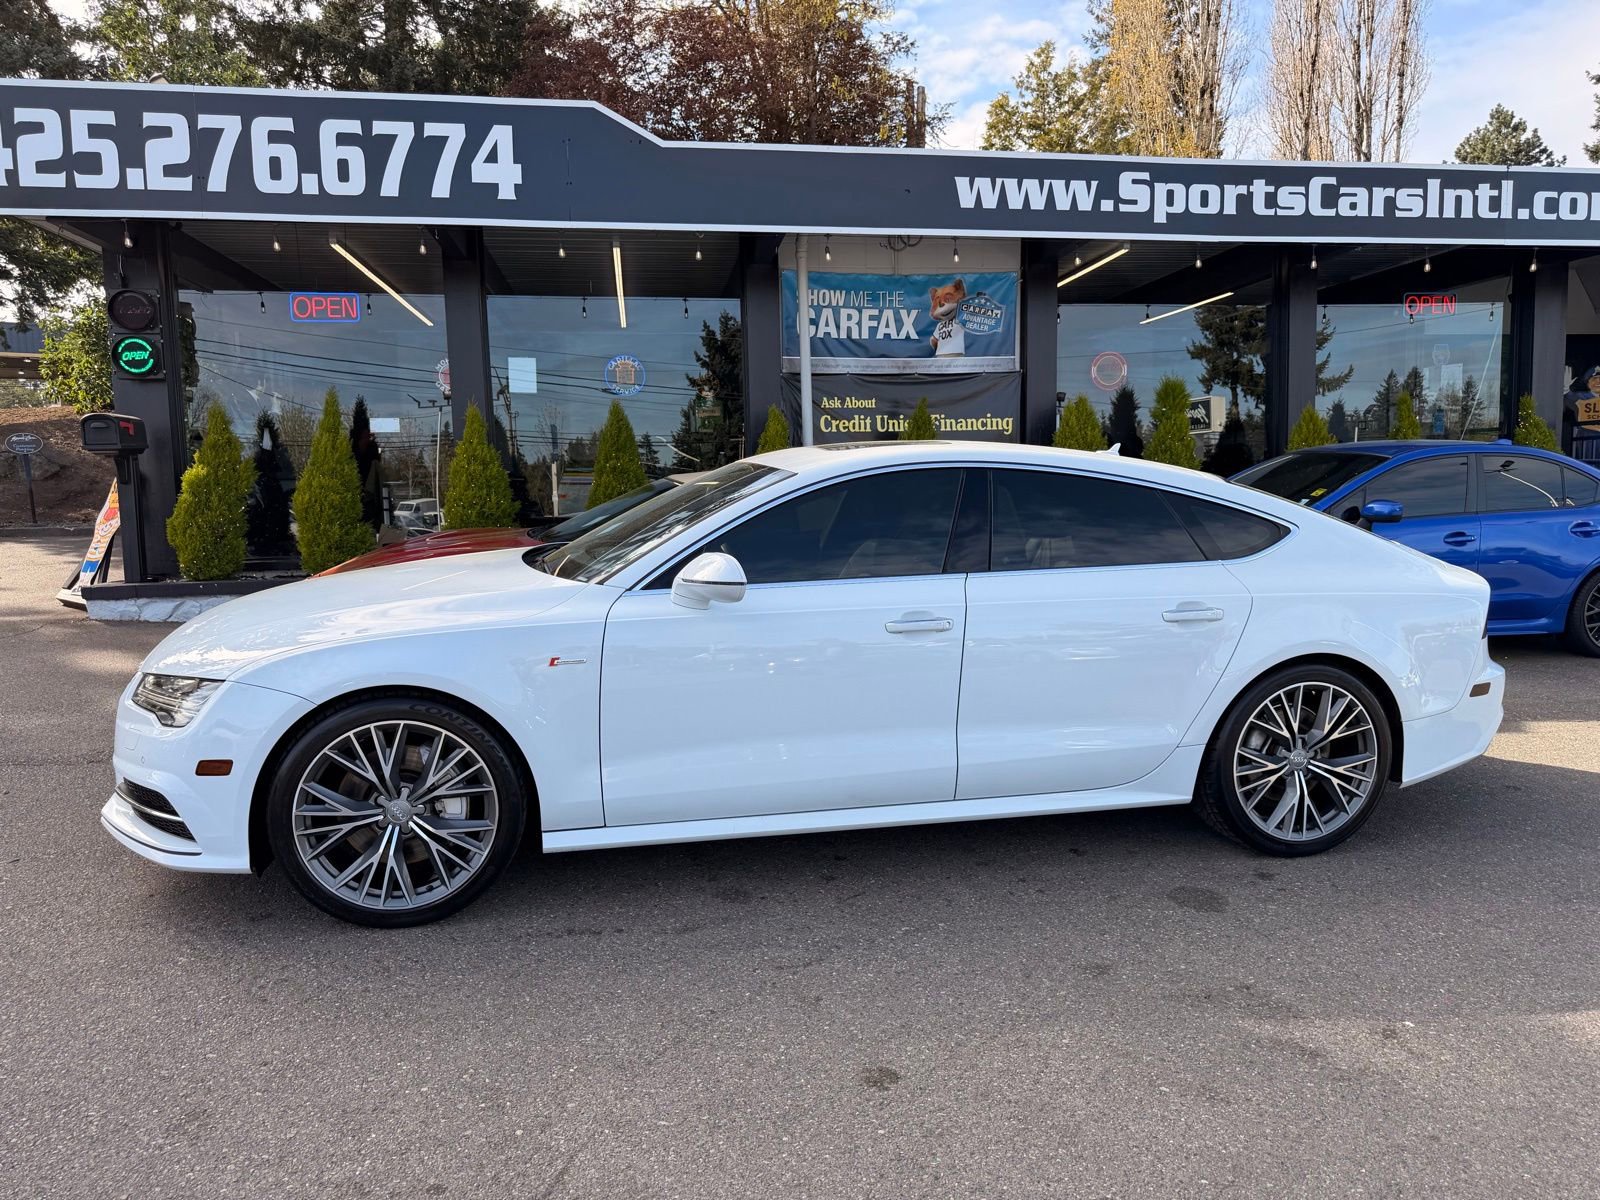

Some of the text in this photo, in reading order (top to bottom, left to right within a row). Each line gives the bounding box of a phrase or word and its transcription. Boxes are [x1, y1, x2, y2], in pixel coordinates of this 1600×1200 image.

[954, 171, 1600, 223] www.SportsCarsIntl.co
[797, 289, 904, 308] HOW ME THE
[1405, 295, 1456, 315] OPEN
[293, 296, 357, 318] OPEN
[961, 304, 1001, 319] CARFAX
[797, 308, 919, 339] CARFAX
[938, 319, 954, 332] CAR
[962, 314, 996, 326] ADVANTAGE
[965, 322, 989, 332] DEALER
[938, 329, 953, 340] FOX
[121, 350, 150, 361] OPEN
[820, 397, 876, 409] Ask About
[819, 413, 1014, 435] Credit Uni Financing
